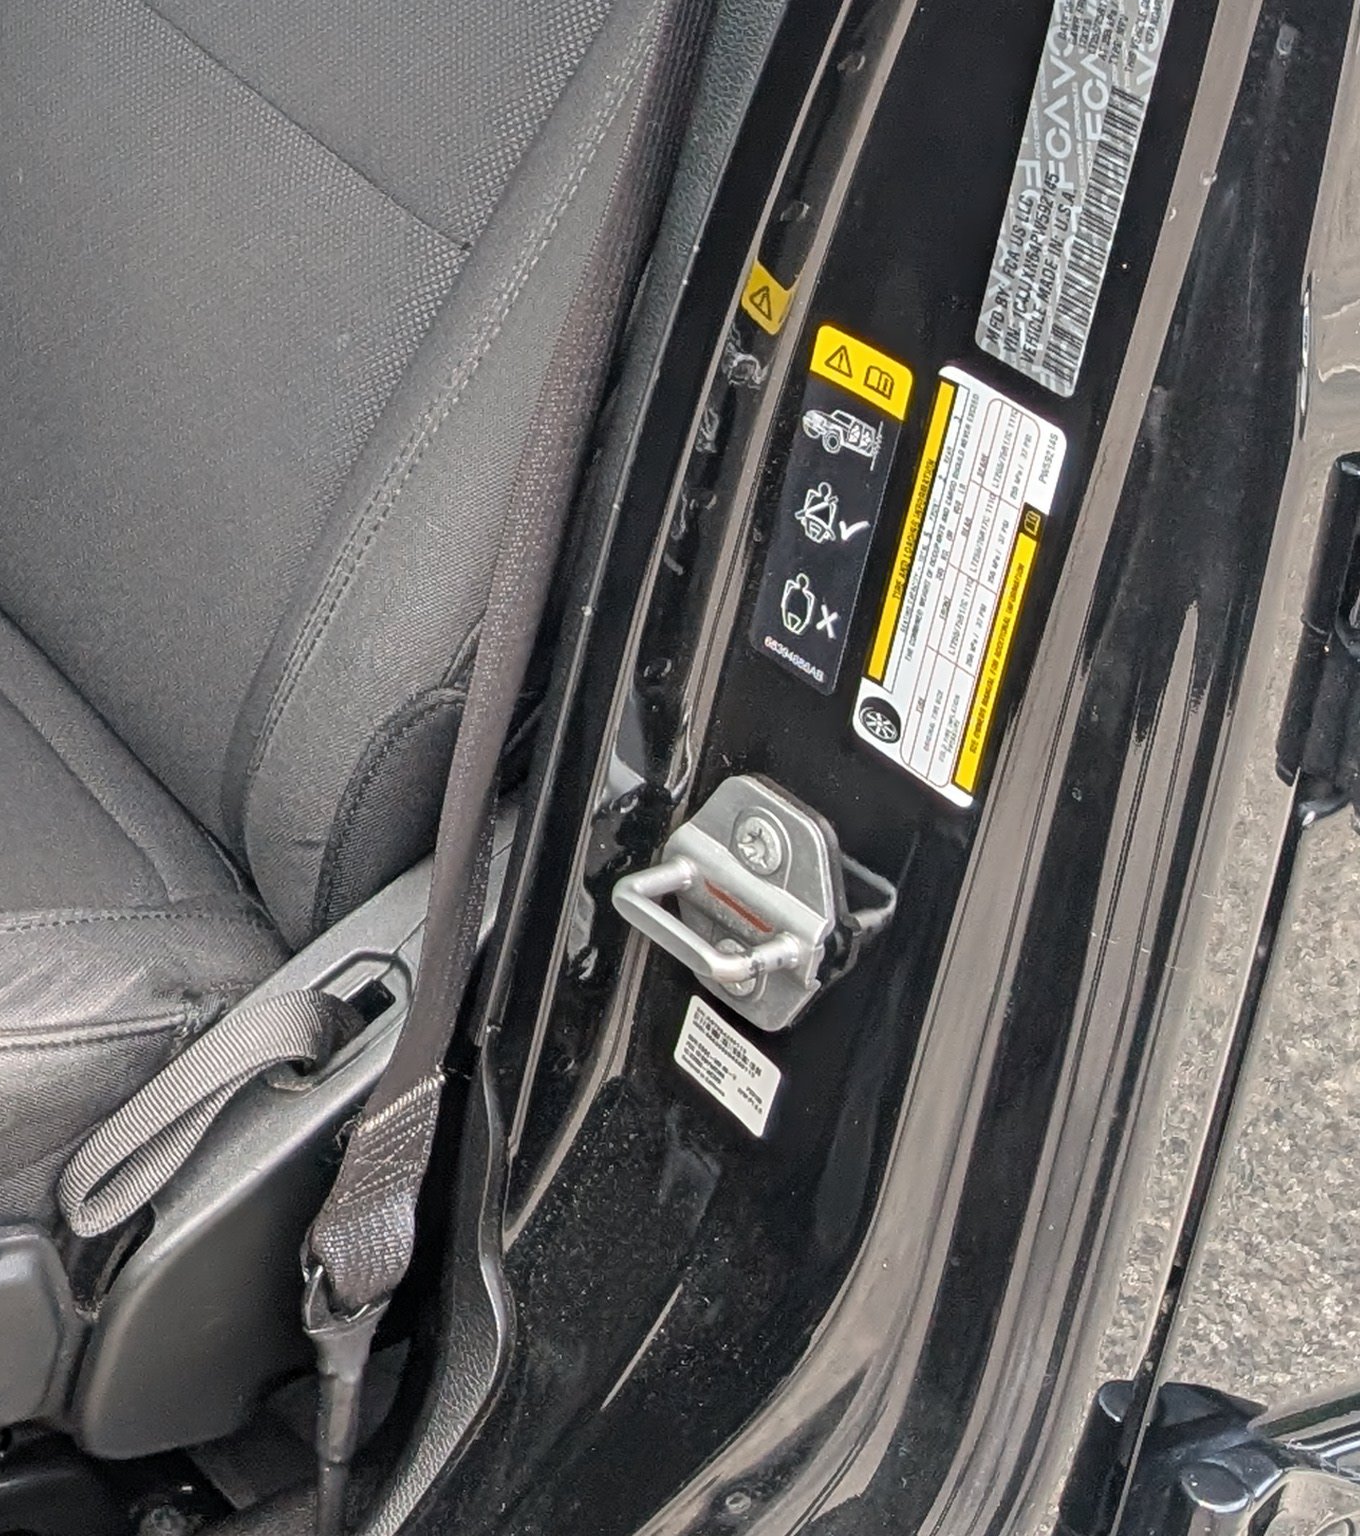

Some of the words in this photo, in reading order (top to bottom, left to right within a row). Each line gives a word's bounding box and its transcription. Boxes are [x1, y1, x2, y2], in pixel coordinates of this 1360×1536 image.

[1015, 193, 1033, 224] LLC
[1010, 224, 1025, 247] US
[1002, 248, 1020, 281] FCA
[995, 281, 1012, 310] BY:
[1021, 303, 1046, 366] VEHICLE
[1036, 257, 1058, 304] MADE
[1047, 232, 1064, 258] IN:
[987, 310, 1005, 346] MFD
[1004, 320, 1022, 356] VIN:
